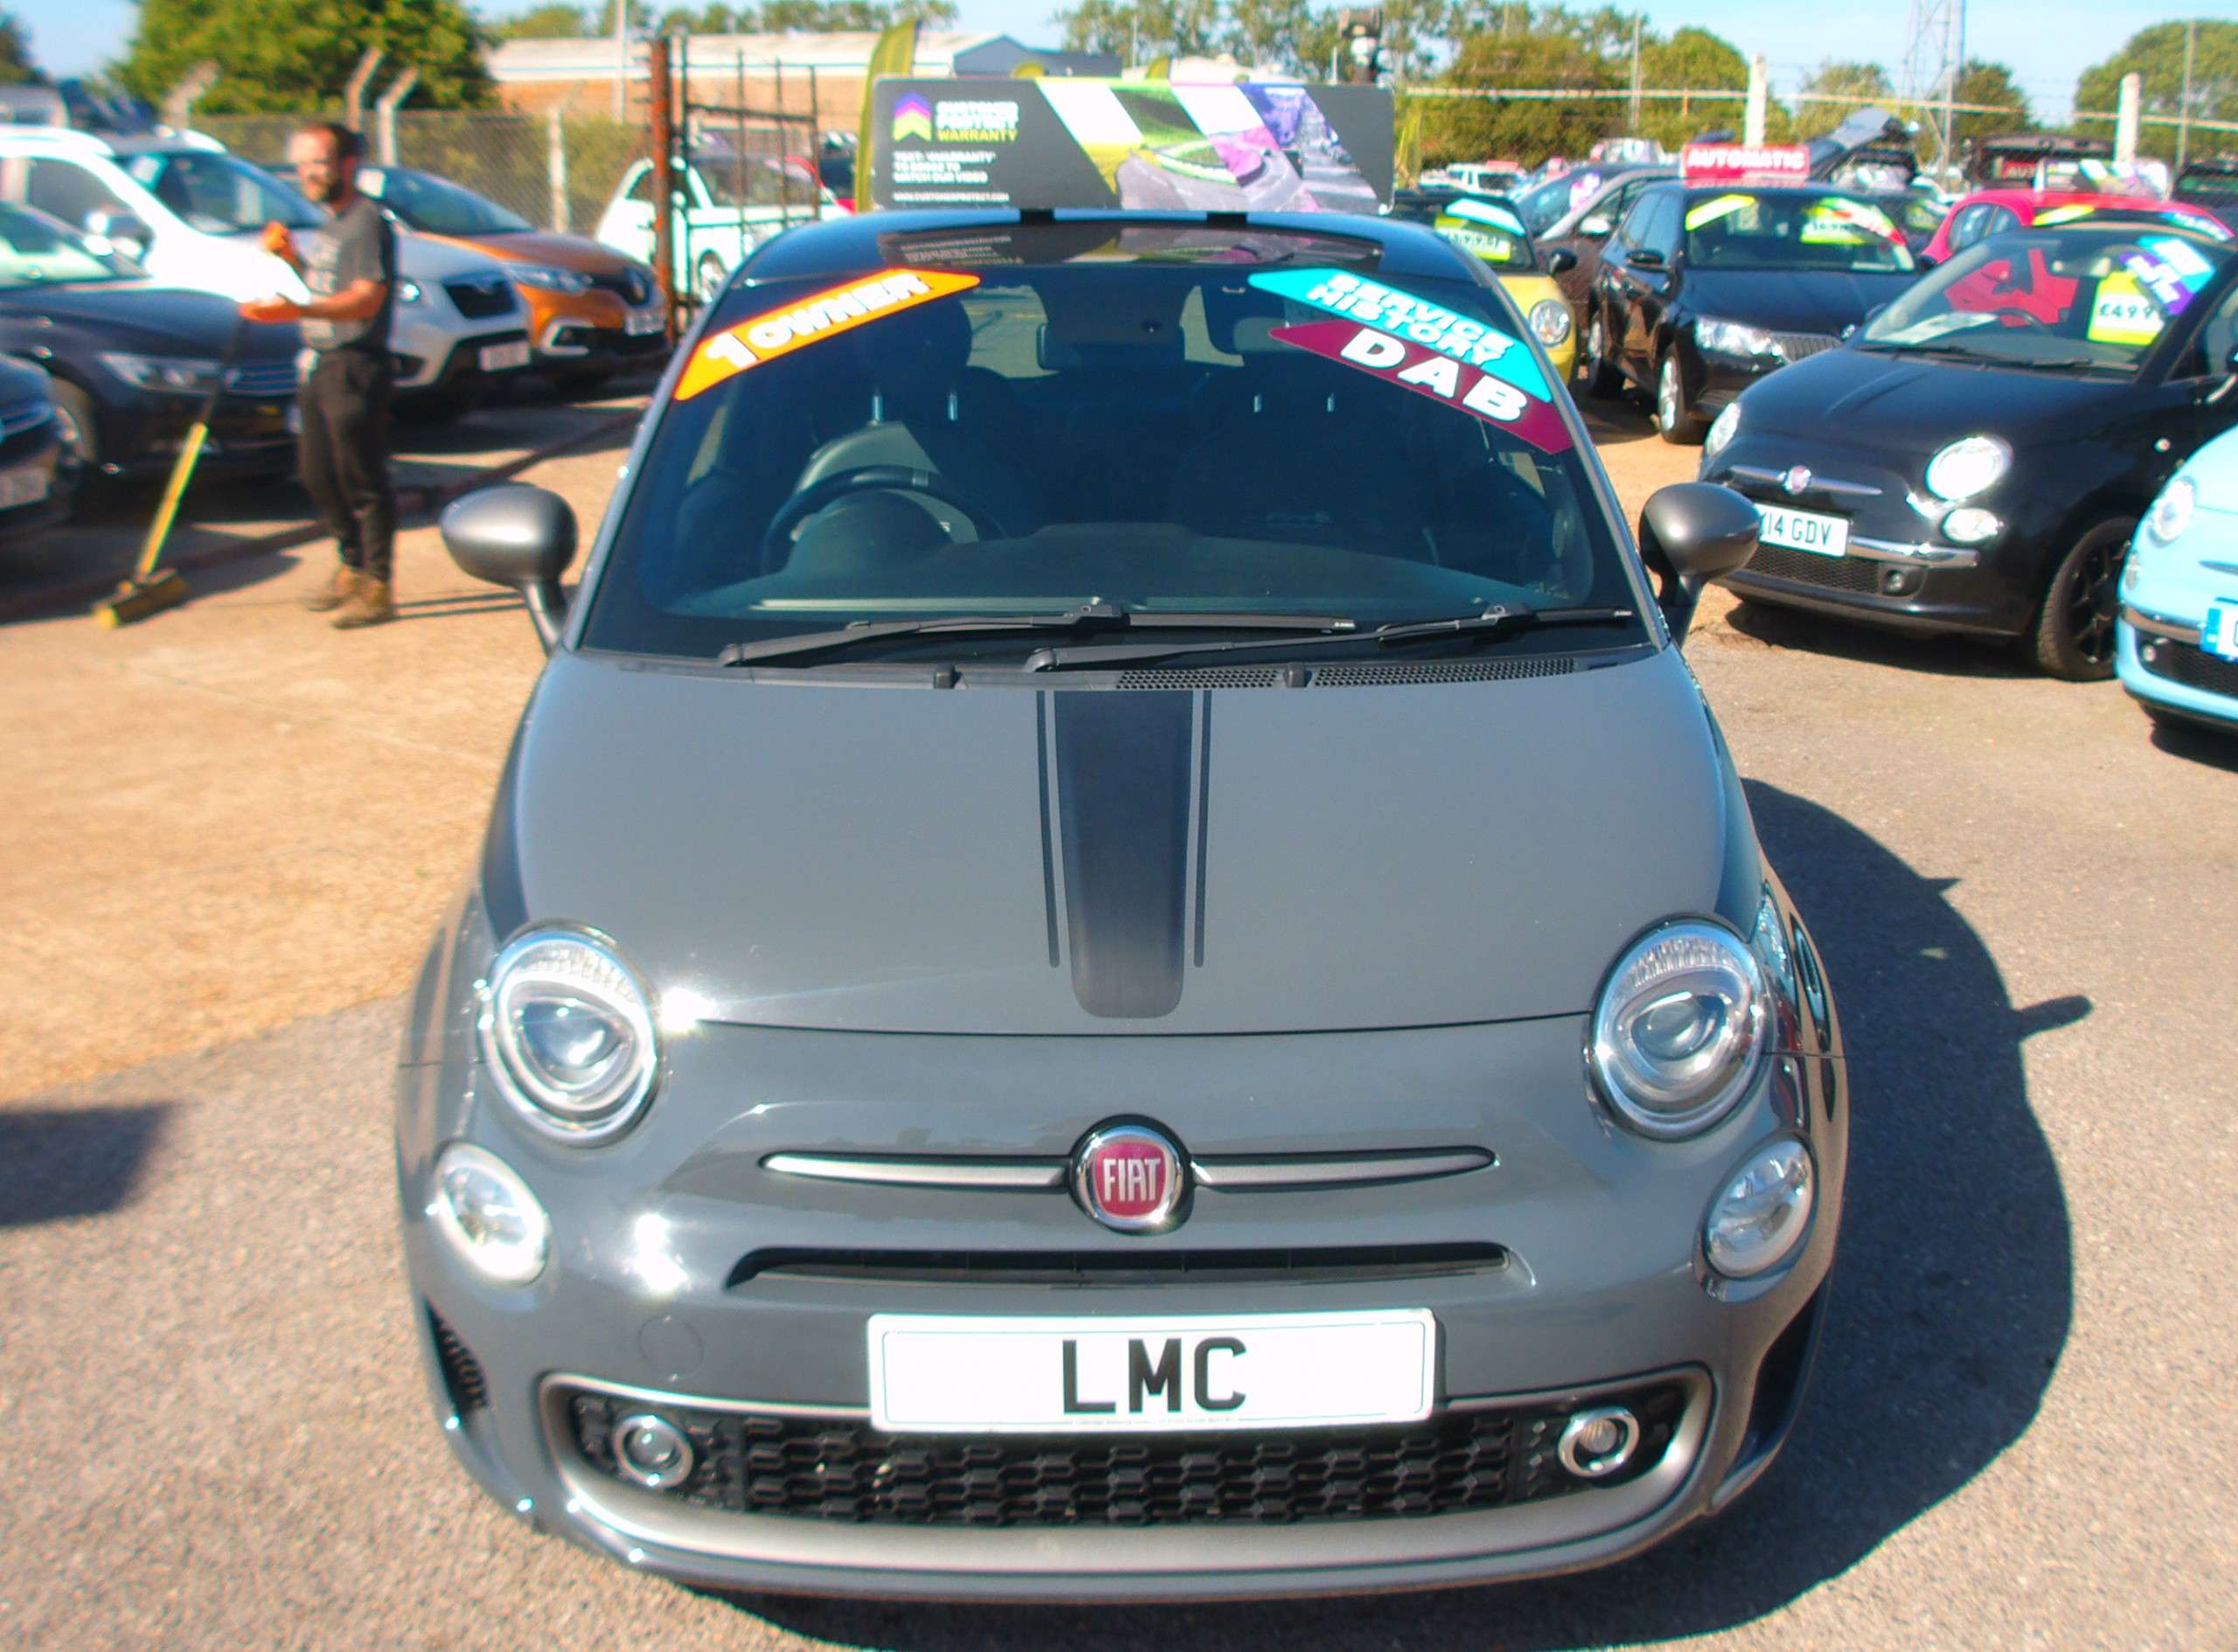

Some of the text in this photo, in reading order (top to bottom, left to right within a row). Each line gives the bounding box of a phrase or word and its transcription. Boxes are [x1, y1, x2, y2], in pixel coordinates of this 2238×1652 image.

[937, 128, 1018, 142] WARRANTY
[1688, 149, 1805, 170] AUTOMATIC
[705, 273, 930, 368] 1 OWNER
[1306, 285, 1506, 366] HISTORY
[1327, 274, 1515, 351] SERVICE
[1340, 329, 1528, 421] DAB
[1792, 517, 1831, 545] GDV
[1103, 1157, 1162, 1204] FIAT
[1061, 1336, 1248, 1415] LMC
